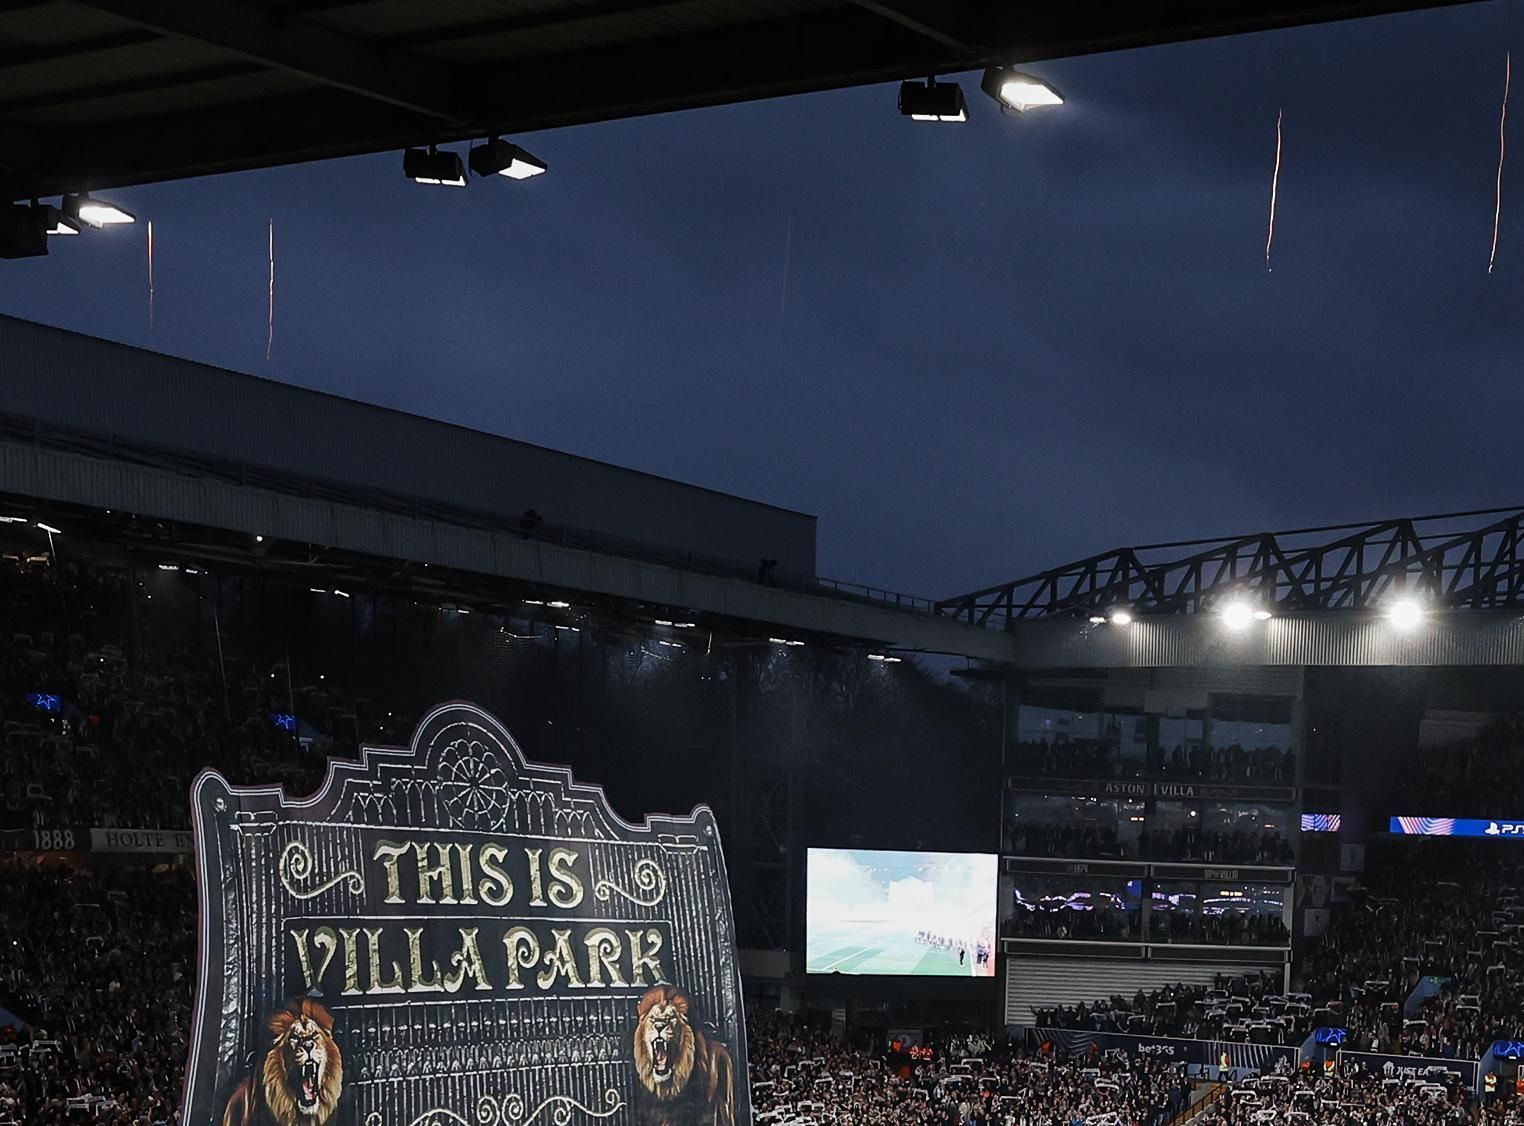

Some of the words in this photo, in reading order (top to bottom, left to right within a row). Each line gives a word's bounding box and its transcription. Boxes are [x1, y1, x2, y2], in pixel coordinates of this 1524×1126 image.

[1104, 783, 1145, 795] ASTON
[1160, 784, 1195, 797] VILLA
[32, 830, 76, 850] 1888
[106, 833, 166, 849] HOLTE
[373, 839, 514, 907] THIS
[523, 847, 585, 910] IS
[289, 926, 494, 998] VILLA
[501, 925, 673, 991] PARK
